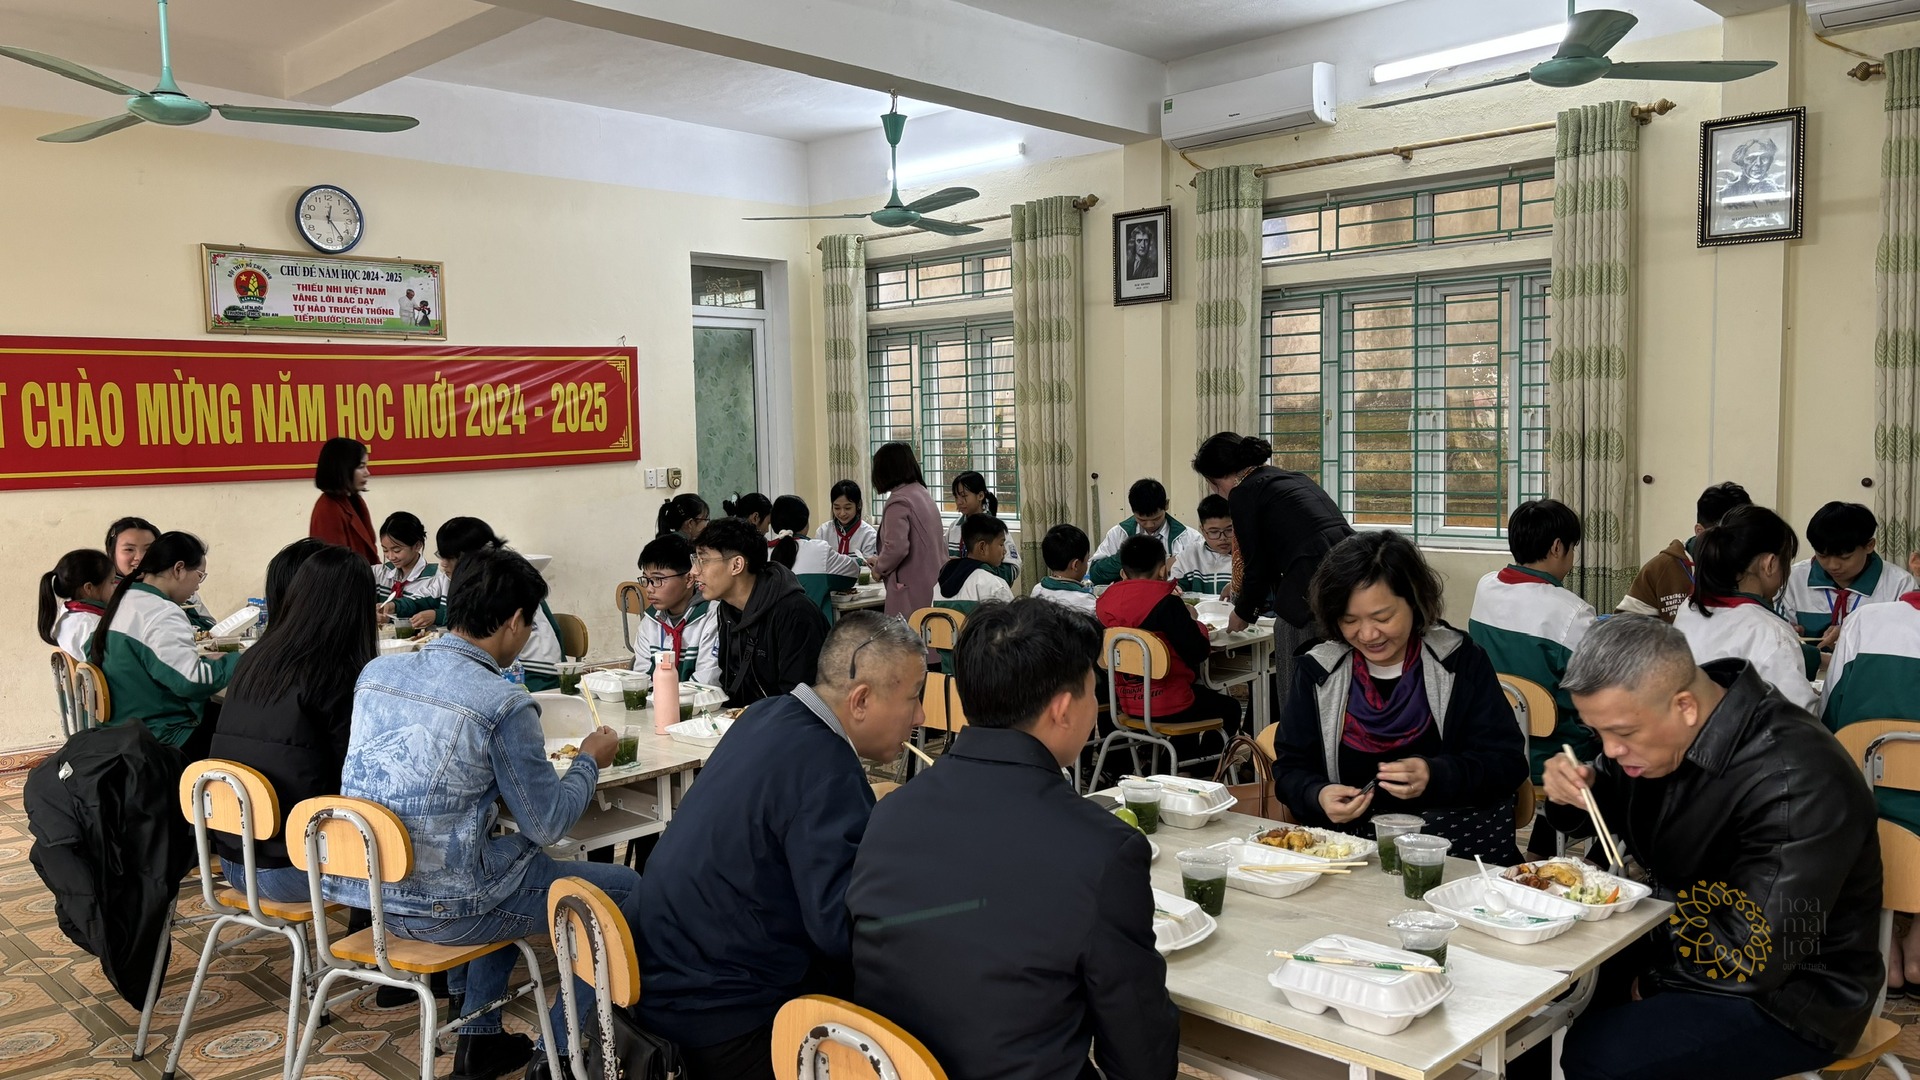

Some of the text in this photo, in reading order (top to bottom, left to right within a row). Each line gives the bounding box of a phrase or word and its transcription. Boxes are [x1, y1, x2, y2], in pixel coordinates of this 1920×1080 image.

[324, 194, 333, 202] 12
[280, 263, 301, 277] CHỦ
[303, 264, 317, 278] ĐỀ
[318, 266, 340, 279] NĂM
[341, 269, 361, 282] HỌC
[362, 270, 379, 281] 2024
[385, 271, 403, 283] 2025
[326, 284, 342, 294] NHI
[344, 285, 363, 296] VIỆT
[366, 287, 386, 296] NAM
[292, 293, 375, 306] VÂNG LỜI BÁC DẠY
[293, 304, 395, 316] TỰ HÀO TRUYỀN THỐNG
[293, 313, 315, 322] TIẾP
[317, 314, 342, 323] BƯỚC
[344, 316, 363, 324] CHA
[21, 367, 125, 449] CHÀO
[135, 368, 243, 446] MỪNG
[251, 370, 328, 443] NĂM
[335, 383, 395, 454] HỌC
[403, 371, 457, 439] MỚI
[464, 383, 527, 437] 2024
[534, 406, 544, 417] -
[551, 382, 608, 433] 2025
